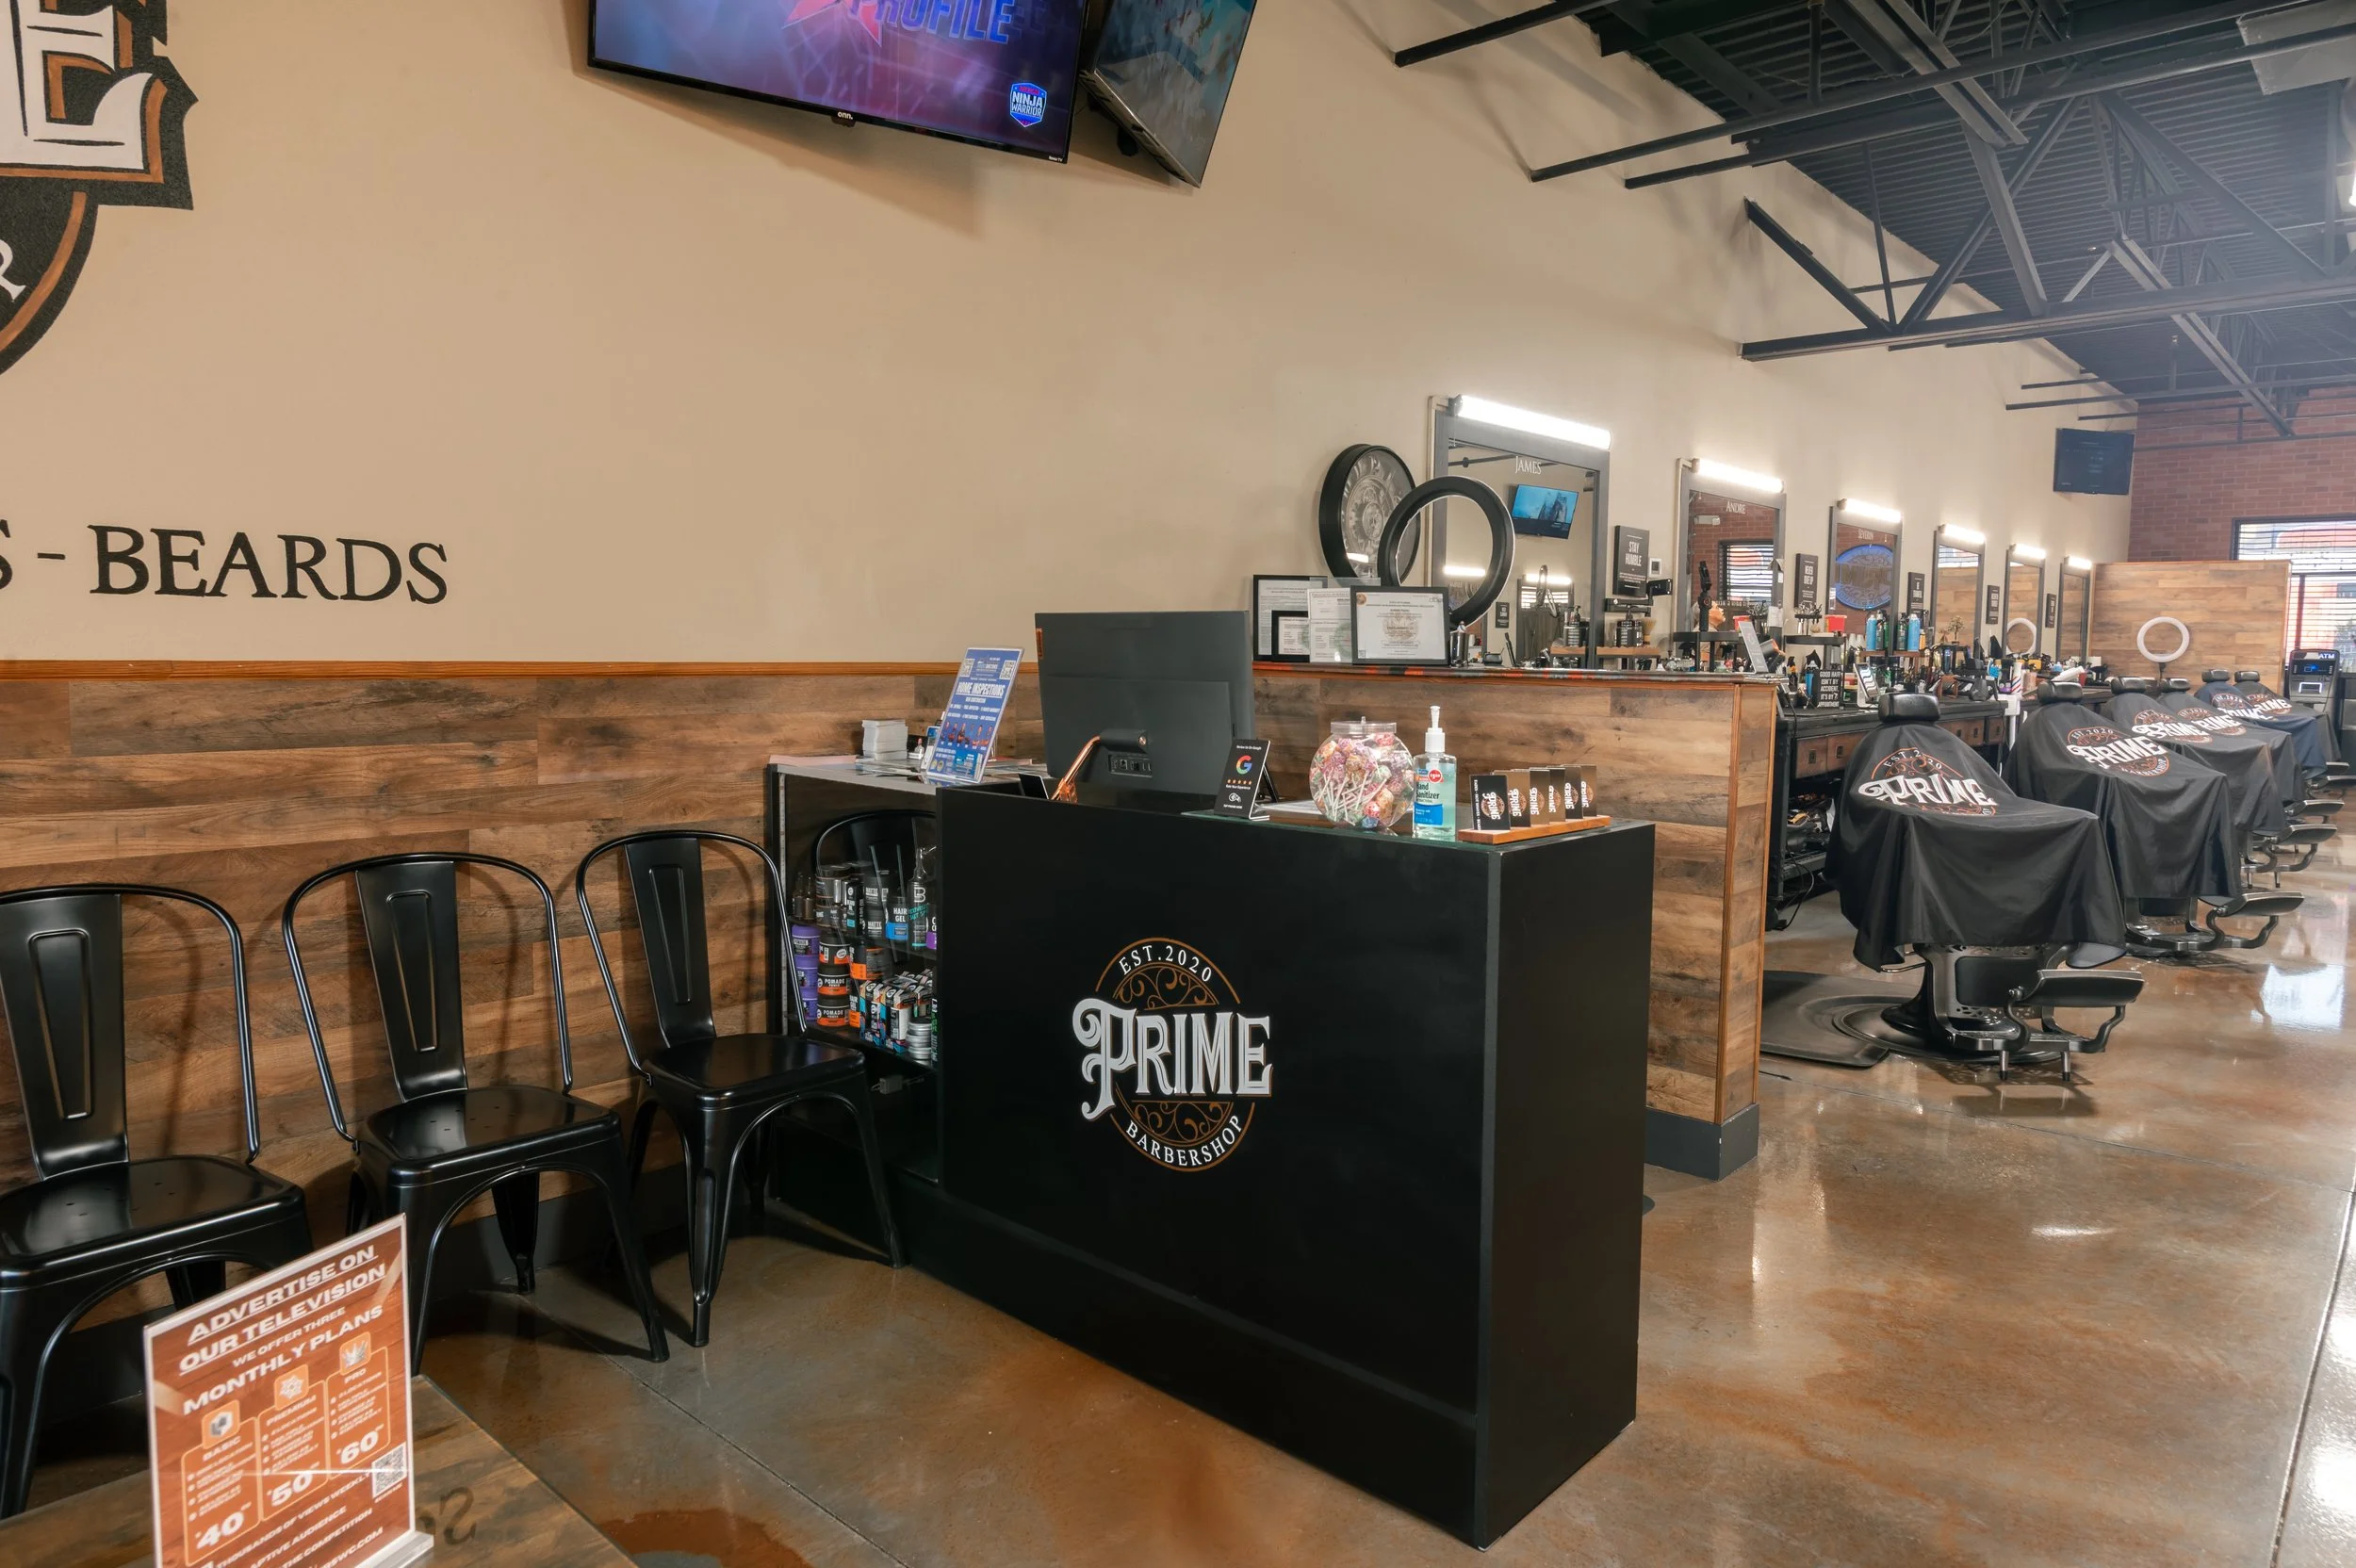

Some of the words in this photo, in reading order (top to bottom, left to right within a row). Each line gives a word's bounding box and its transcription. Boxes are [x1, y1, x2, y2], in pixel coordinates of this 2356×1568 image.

[1011, 102, 1042, 117] WARRIOR
[1012, 90, 1043, 107] NINJA
[1514, 455, 1542, 475] JAMES
[1726, 500, 1746, 514] ANDRE
[1625, 552, 1642, 566] HUMBLE
[1628, 541, 1640, 553] STAY
[87, 524, 448, 604] BEARDS
[2191, 715, 2243, 731] RIME
[2066, 736, 2168, 769] PRIME
[1858, 774, 1999, 806] PRIME
[1118, 945, 1213, 983] EST.2020
[1072, 998, 1273, 1120] PRIME
[1125, 1115, 1243, 1168] BARBERSHOP
[188, 1262, 337, 1344] ADVERTISE
[339, 1245, 375, 1271] ON
[180, 1333, 239, 1371] OUR
[241, 1263, 386, 1342] TELEVISION
[232, 1350, 257, 1367] WE
[257, 1329, 303, 1356] OFFER
[303, 1307, 347, 1334] THREE
[183, 1341, 307, 1413] MONTHLY
[309, 1304, 384, 1351] PLANS
[344, 1368, 367, 1384] PRO
[266, 1395, 317, 1427] PREMIUM
[203, 1436, 241, 1462] BASIC
